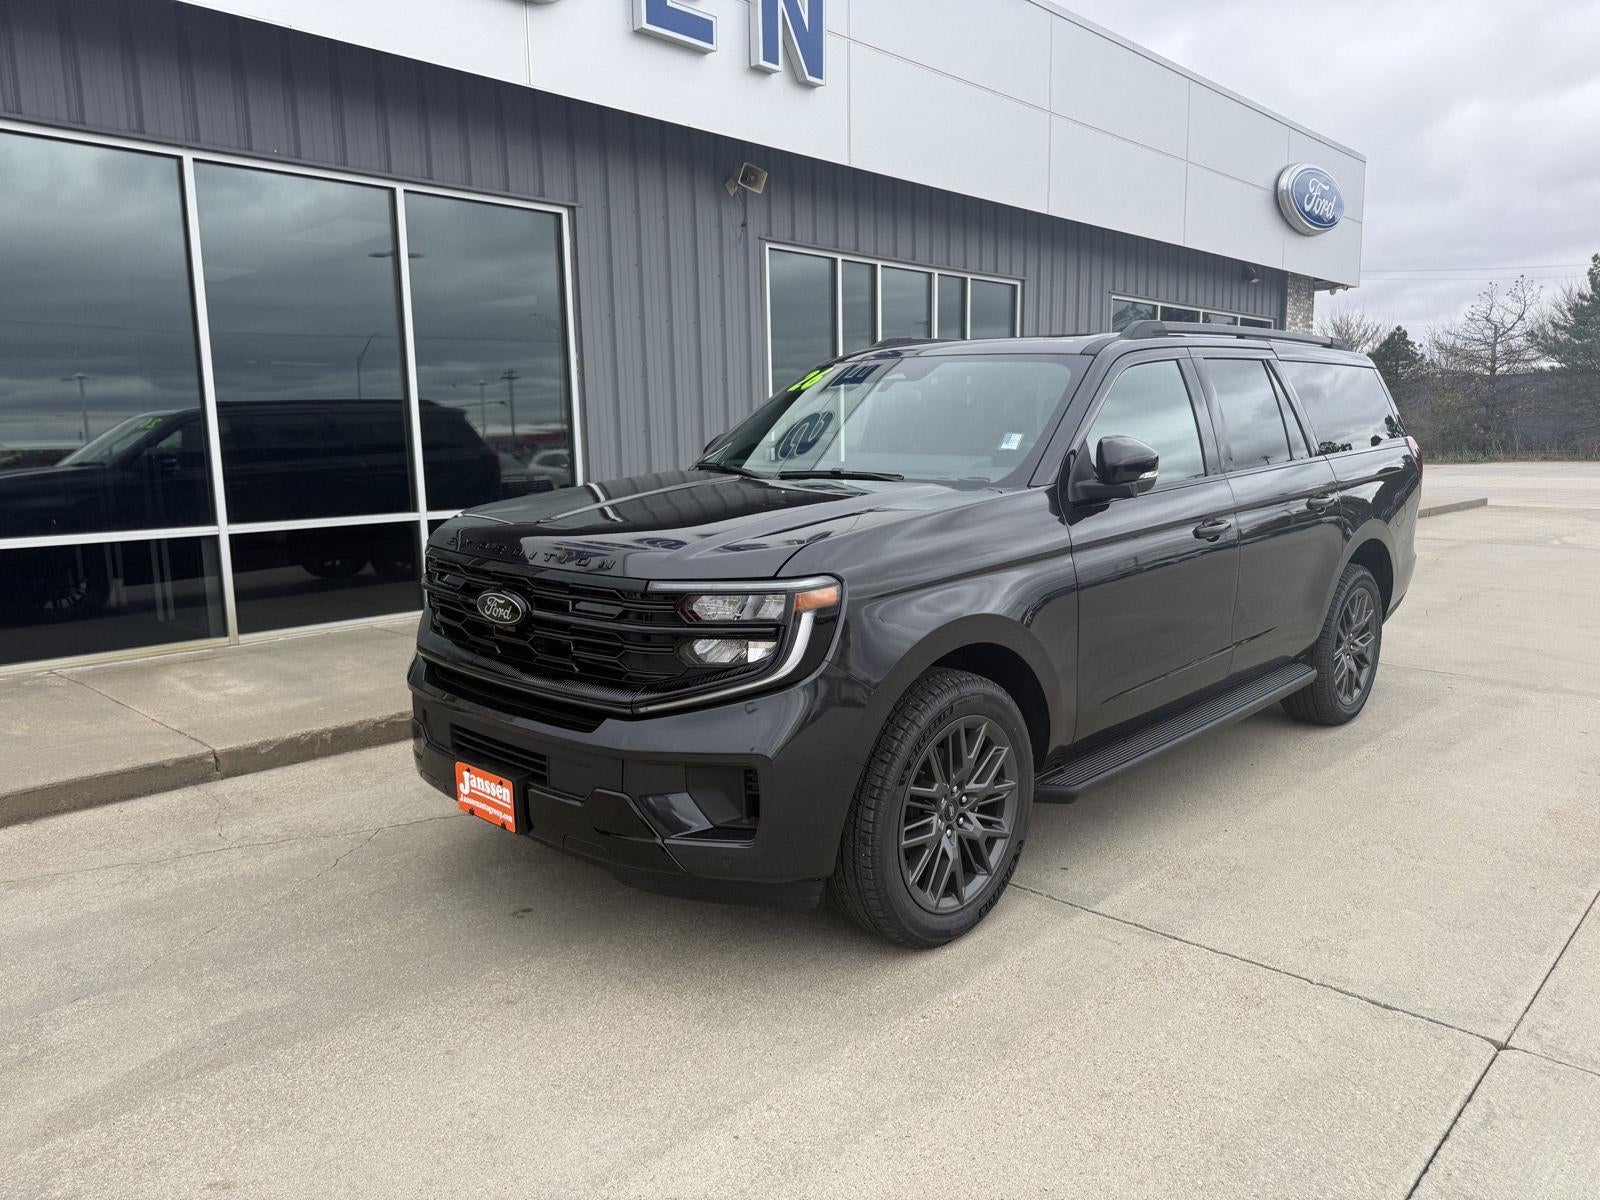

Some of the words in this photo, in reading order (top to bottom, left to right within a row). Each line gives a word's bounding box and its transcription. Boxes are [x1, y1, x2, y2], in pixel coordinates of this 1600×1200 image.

[1304, 178, 1337, 220] Ford
[485, 596, 513, 620] Ford
[460, 770, 511, 803] Janssen
